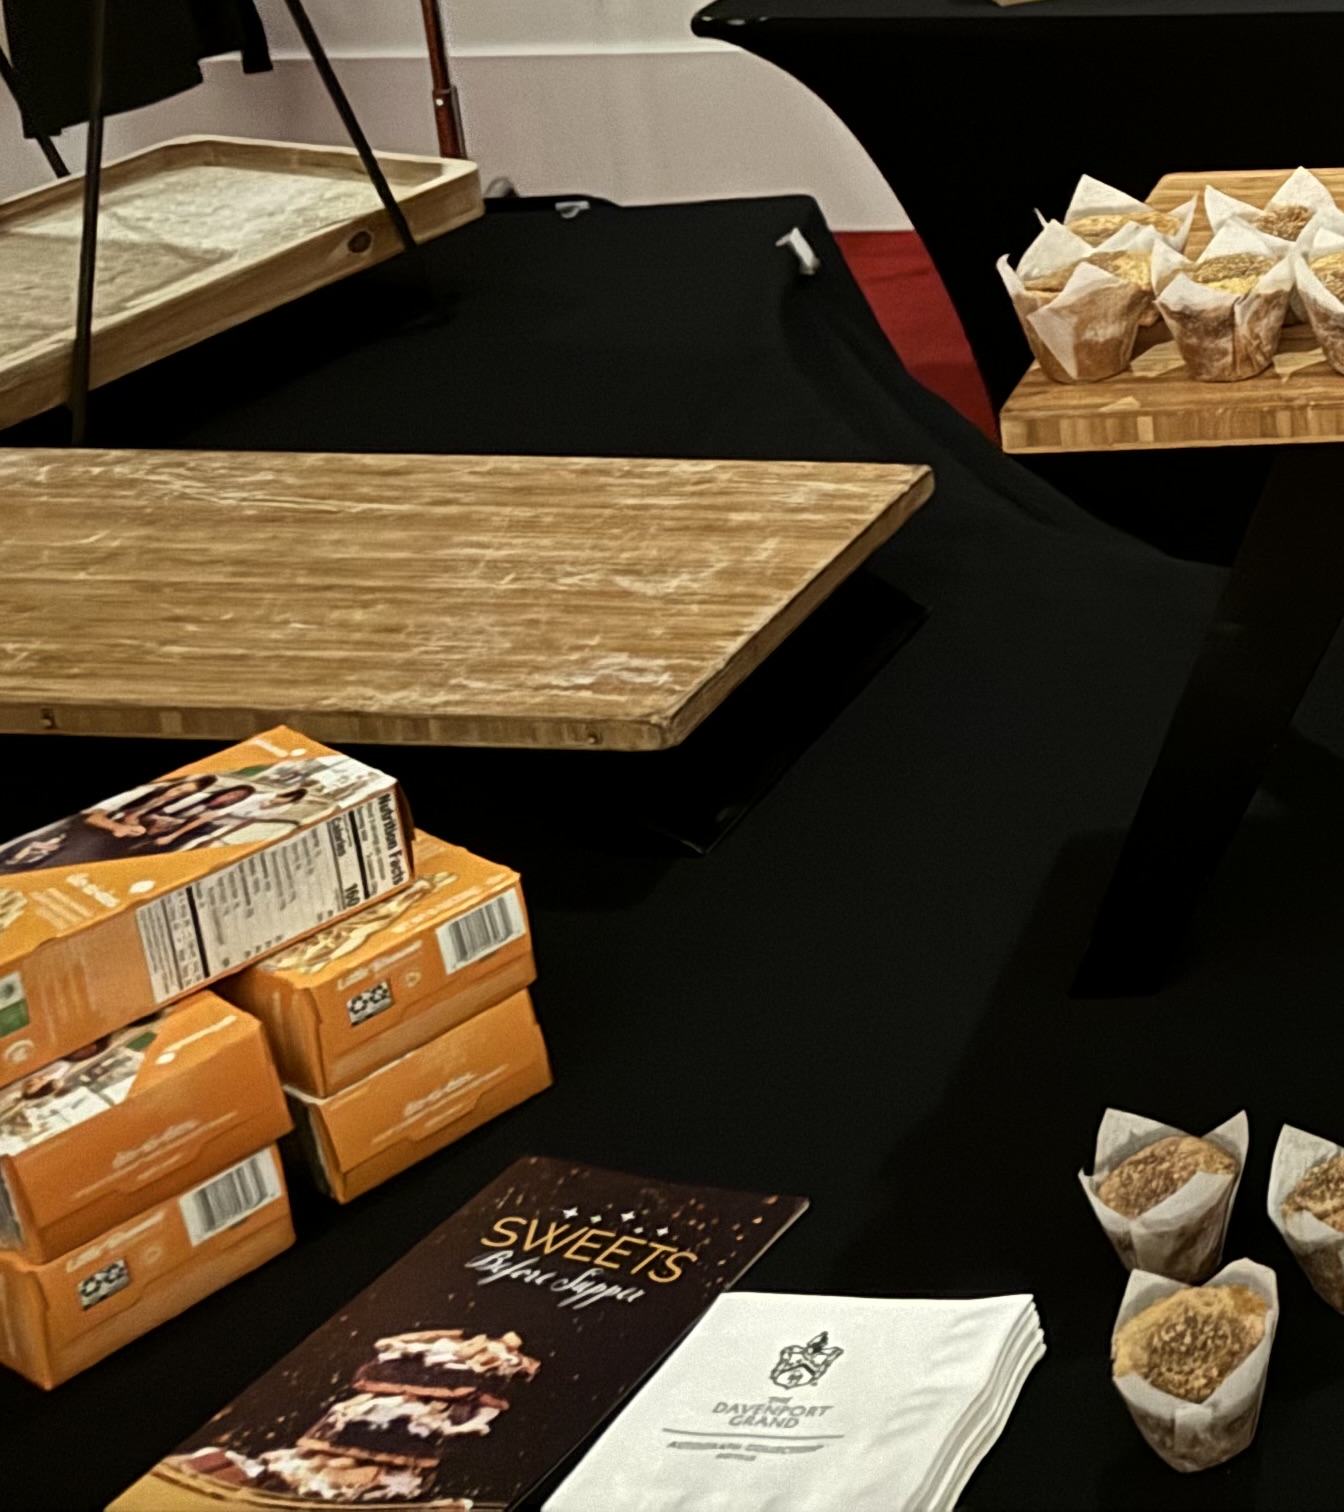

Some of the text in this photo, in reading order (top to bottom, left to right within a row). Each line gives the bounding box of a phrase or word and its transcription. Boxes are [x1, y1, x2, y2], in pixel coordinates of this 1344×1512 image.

[480, 1216, 698, 1283] SWEETS
[712, 1401, 834, 1418] DAVENPORT
[728, 1414, 799, 1429] GRAND
